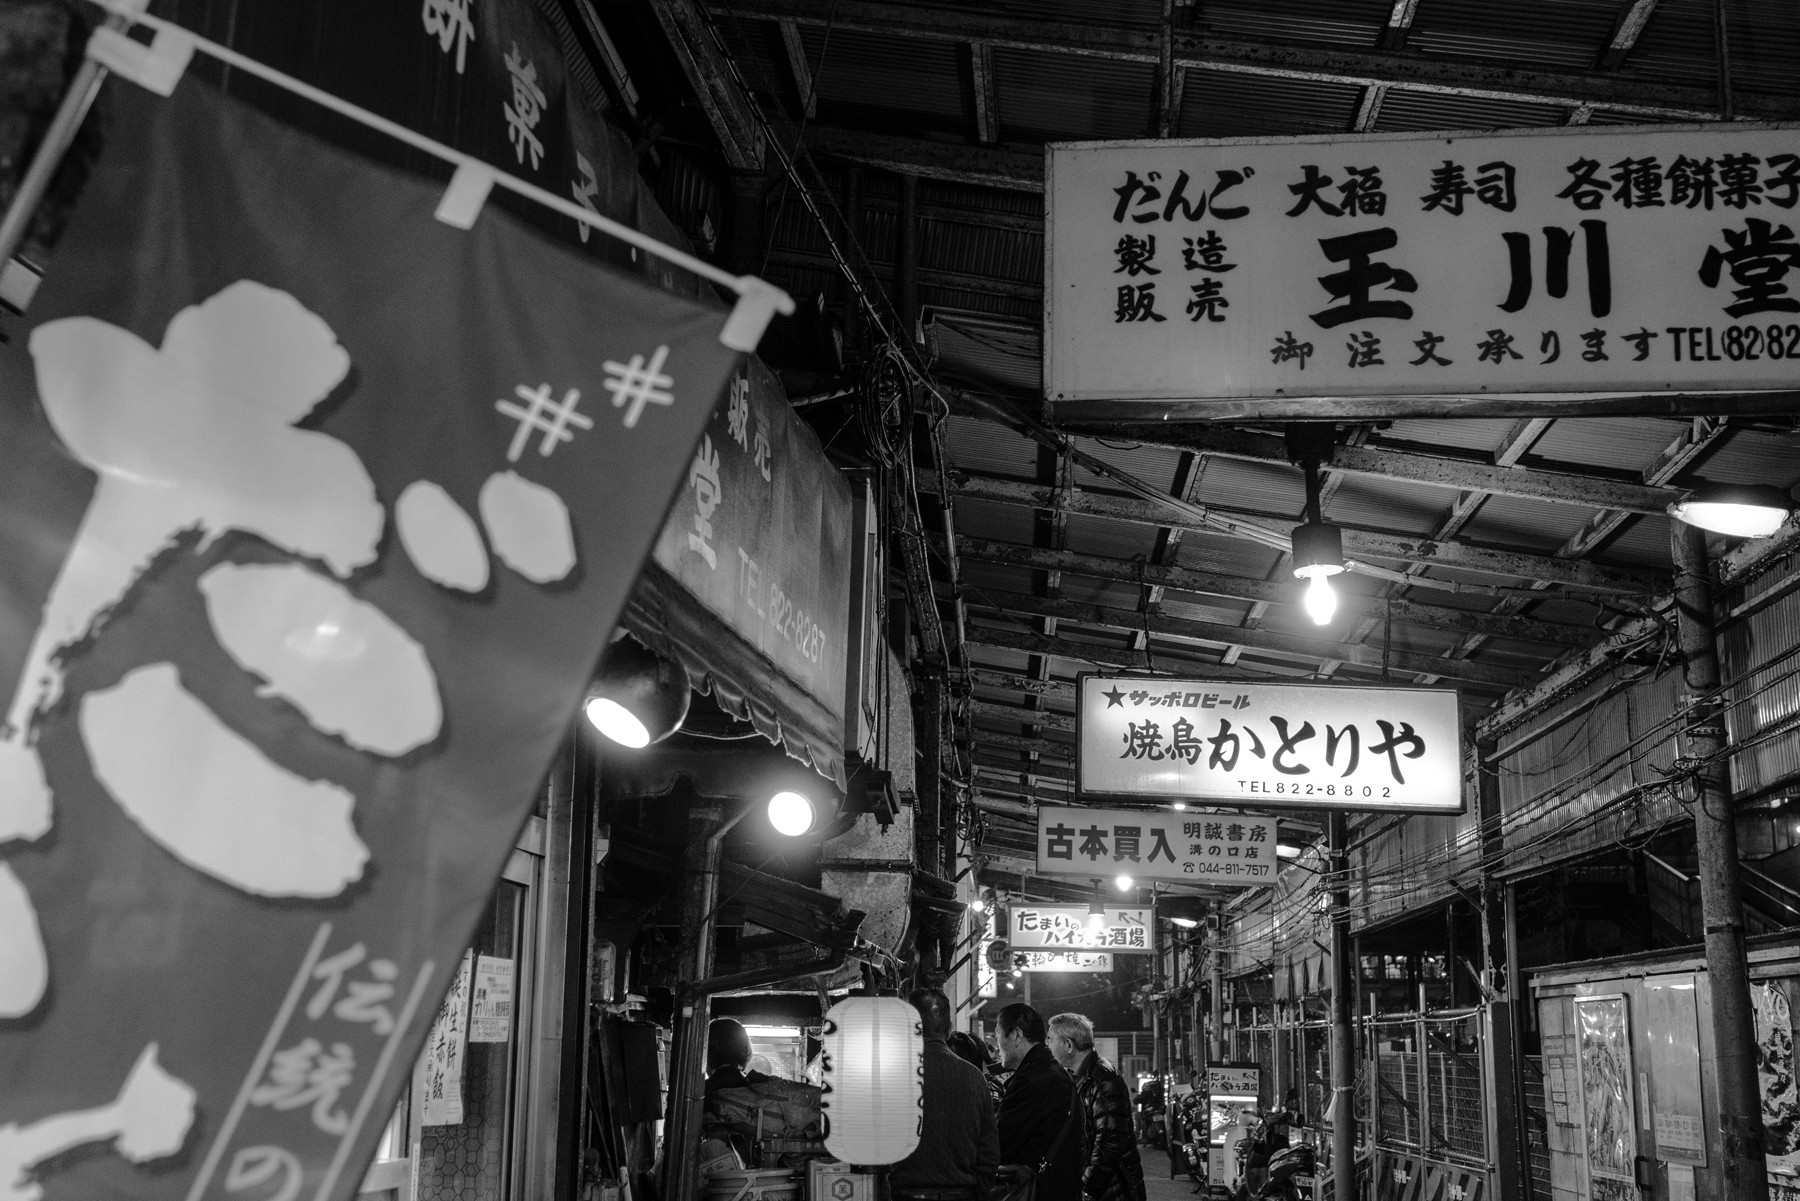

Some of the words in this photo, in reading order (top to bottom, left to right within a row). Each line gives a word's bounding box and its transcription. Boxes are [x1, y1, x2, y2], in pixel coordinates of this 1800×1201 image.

[1112, 166, 1255, 223] だんご
[1285, 165, 1387, 218] 大福
[1419, 160, 1517, 213] 寿司
[1555, 152, 1800, 211] 各種餅菓子
[1112, 229, 1237, 276] 製造
[1114, 278, 1229, 323] 販売
[1270, 326, 1658, 371] 御注文承ります
[769, 582, 826, 671] 822-8287
[1129, 690, 1251, 710] サッポロビール
[1046, 823, 1177, 864] 古本買入
[1183, 822, 1267, 842] 明誠書房
[1189, 843, 1259, 858] 溝の口店
[1198, 862, 1269, 876] 044-811-7517
[1017, 910, 1080, 931] たまいの
